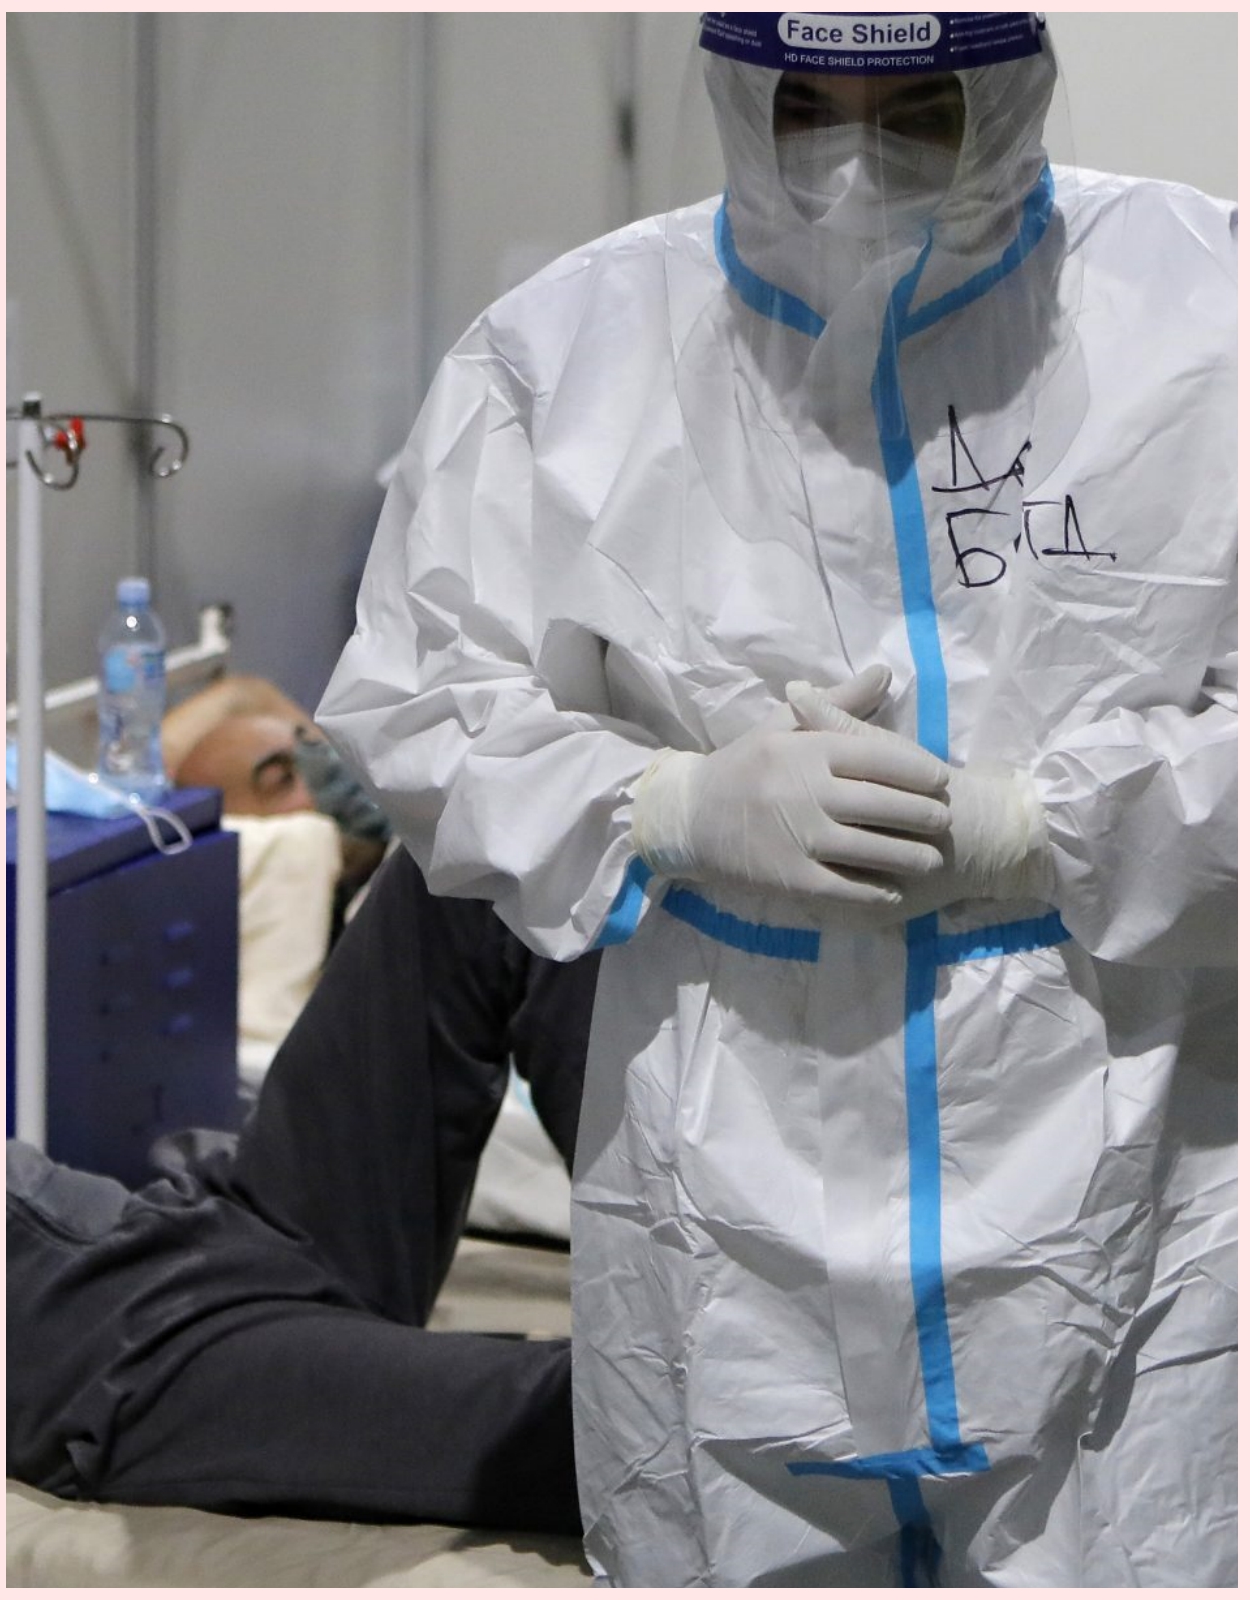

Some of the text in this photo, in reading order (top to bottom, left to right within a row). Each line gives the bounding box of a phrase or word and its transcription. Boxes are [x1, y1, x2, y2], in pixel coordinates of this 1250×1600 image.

[787, 19, 843, 43] Face
[852, 21, 931, 44] Shield
[784, 52, 935, 67] HD FACE SHIELD PROTECTION
